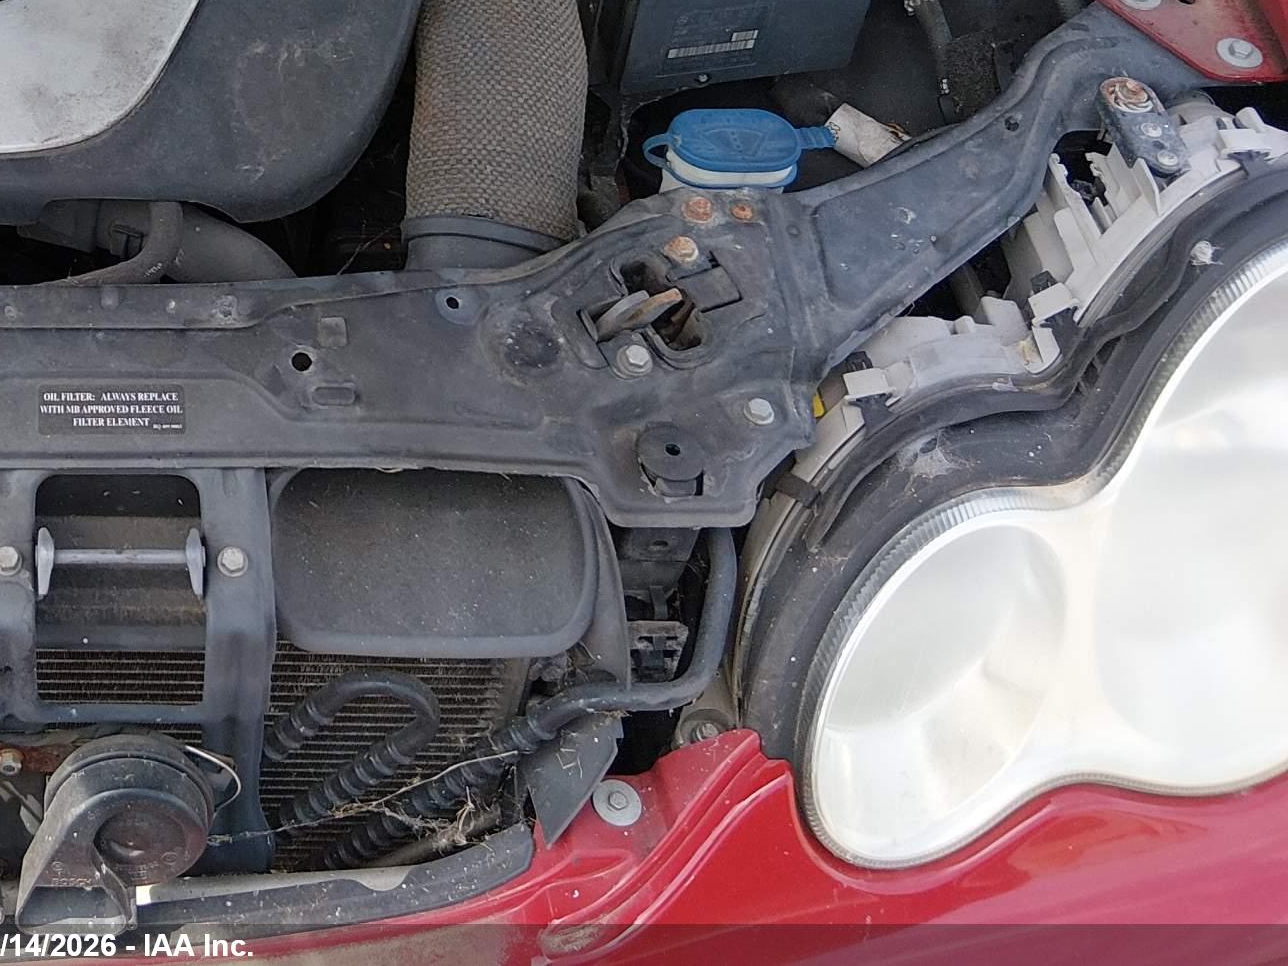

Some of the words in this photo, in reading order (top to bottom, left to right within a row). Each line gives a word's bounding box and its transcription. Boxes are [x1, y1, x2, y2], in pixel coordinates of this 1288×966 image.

[43, 392, 59, 402] OIL
[61, 392, 95, 402] FILTER:
[100, 392, 136, 402] ALWAYS
[138, 392, 179, 402] REPLACE
[40, 404, 64, 414] WITH
[66, 404, 80, 414] MB
[82, 404, 129, 414] APPROVED
[130, 404, 165, 414] FLEECE
[166, 404, 183, 414] OIL
[73, 417, 105, 427] FILTER
[106, 417, 150, 427] ELEMENT
